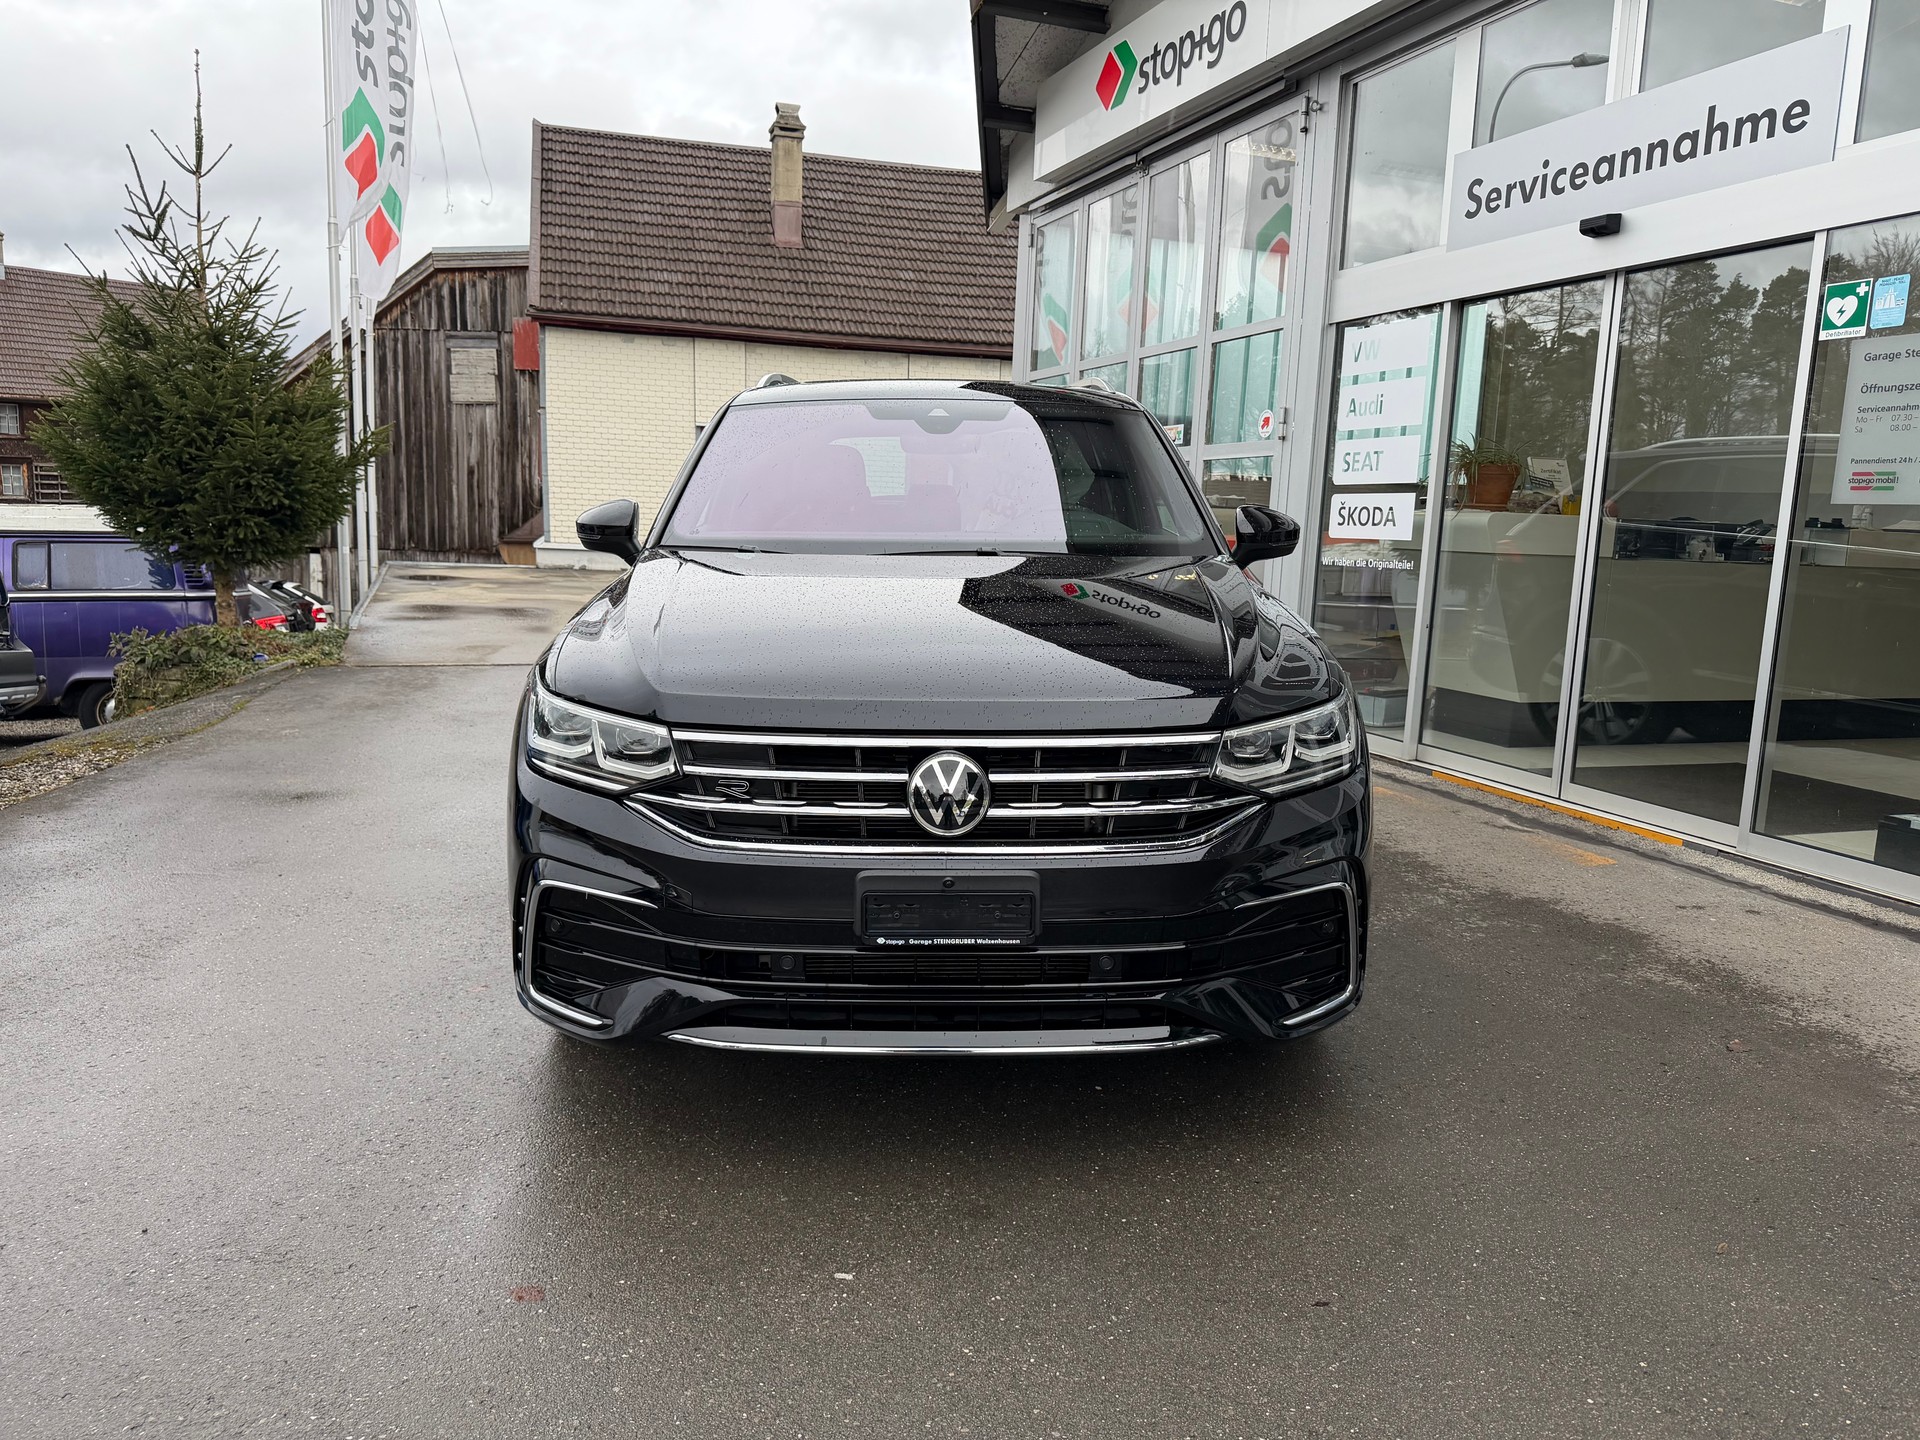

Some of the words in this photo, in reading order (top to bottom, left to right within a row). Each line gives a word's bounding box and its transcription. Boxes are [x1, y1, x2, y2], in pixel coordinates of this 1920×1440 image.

[1138, 0, 1247, 95] stop+go
[1464, 98, 1811, 220] Serviceannahme
[1825, 329, 1861, 338] Defibrillator
[1351, 339, 1380, 363] VW
[1864, 350, 1902, 363] Garage
[1346, 393, 1384, 418] Audi
[1856, 416, 1868, 424] Mo
[1875, 415, 1883, 423] Fr
[1891, 413, 1913, 422] 07.30
[1854, 425, 1863, 434] Sa
[1890, 423, 1911, 432] 08.00
[1342, 450, 1384, 473] SEAT
[1850, 457, 1897, 465] Pannendienst
[1337, 501, 1397, 527] ŠKODA
[1322, 556, 1334, 566] Wir
[1334, 556, 1355, 567] haben
[1355, 557, 1367, 568] die
[1367, 558, 1414, 571] Originalteile!
[908, 938, 933, 946] Garage
